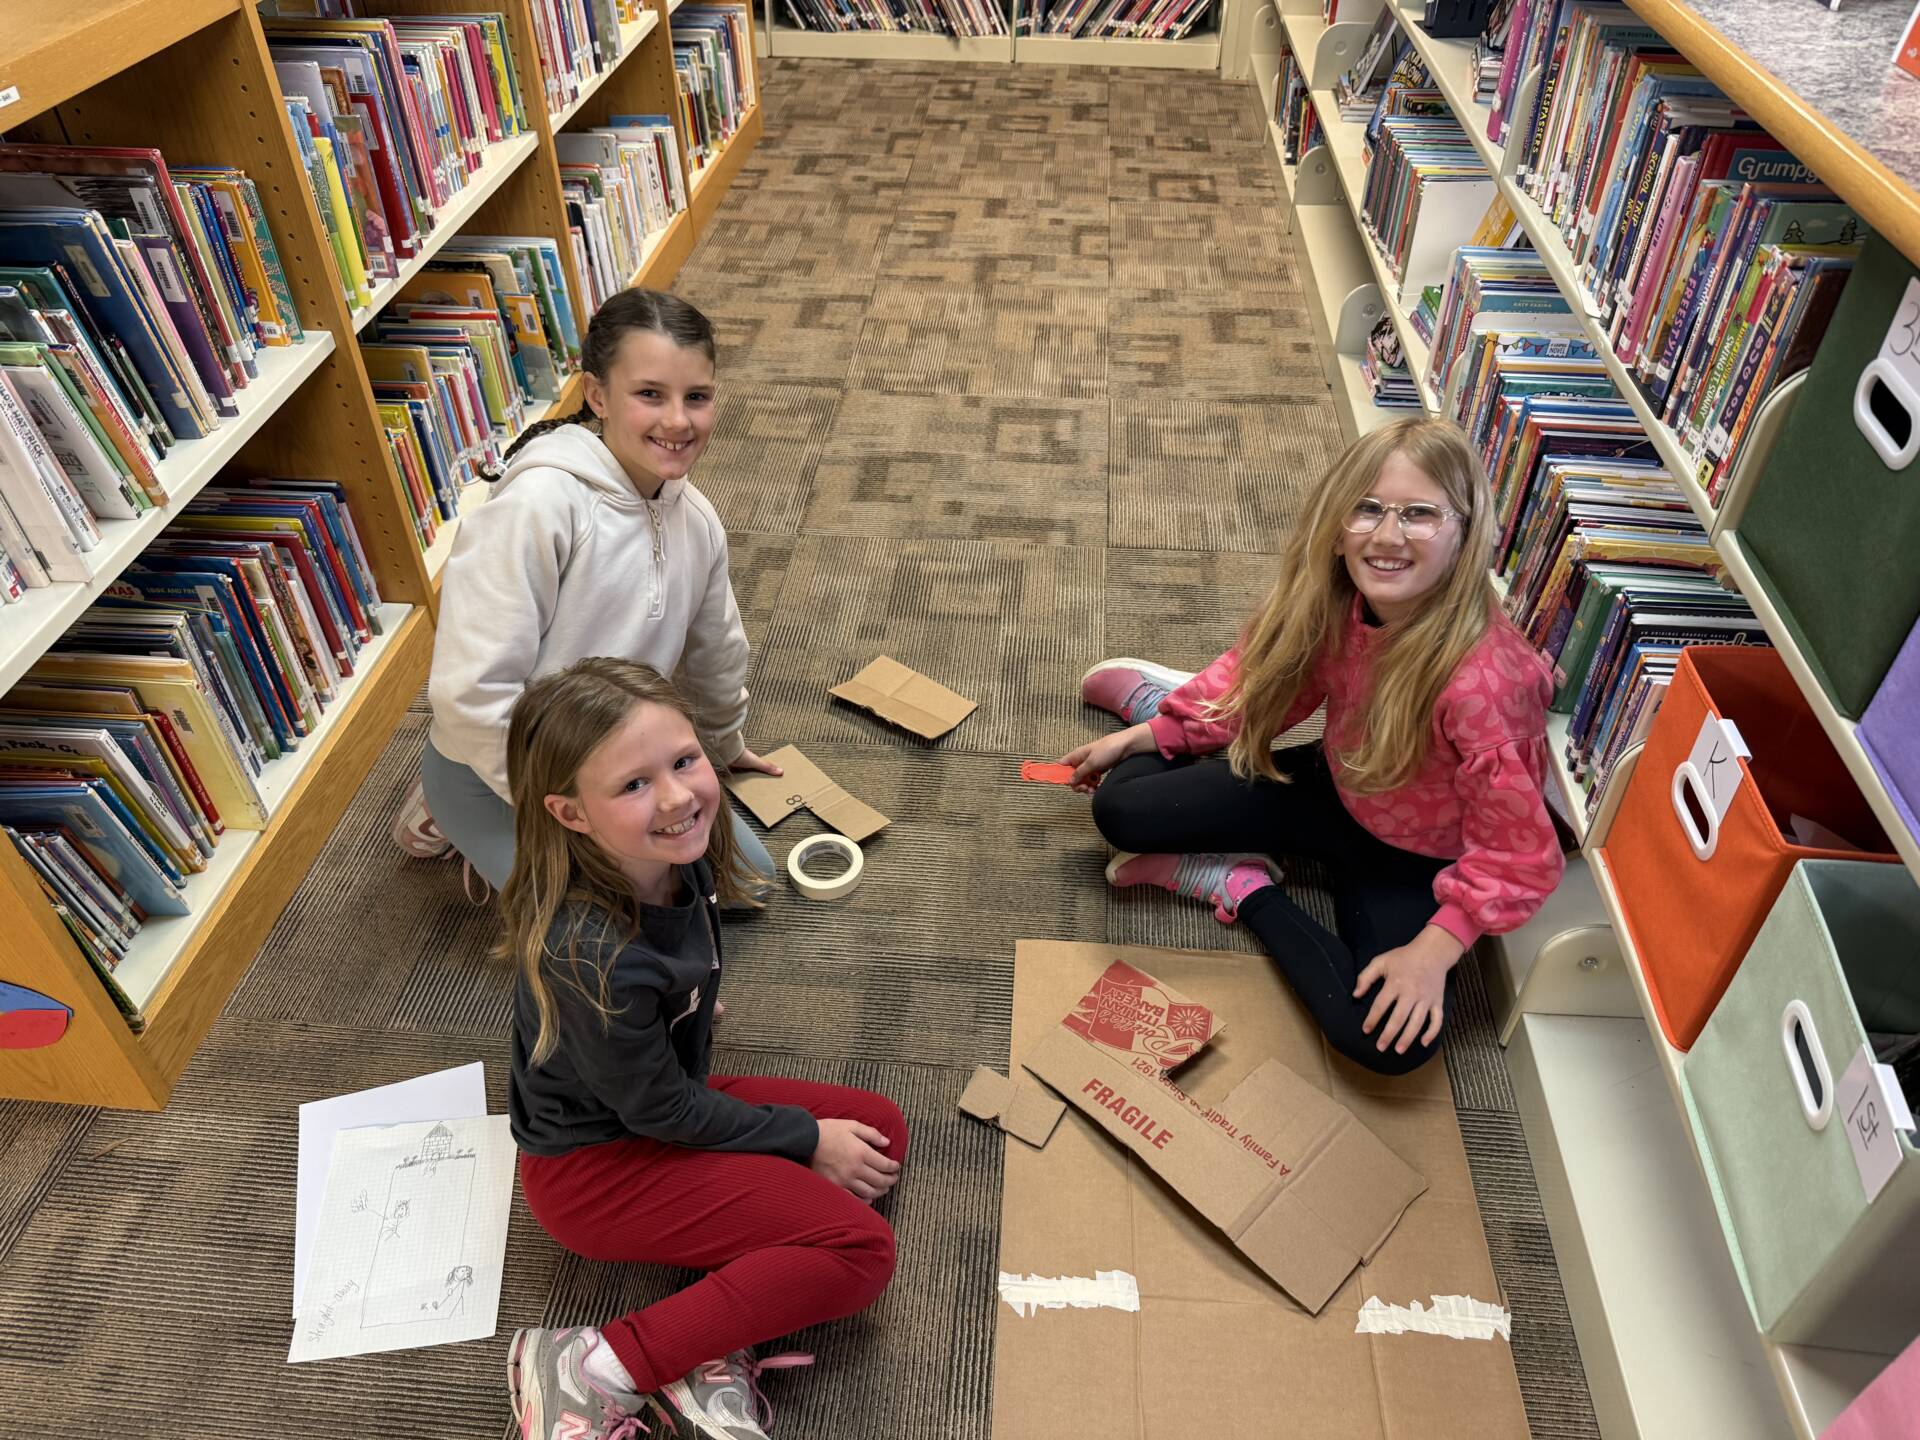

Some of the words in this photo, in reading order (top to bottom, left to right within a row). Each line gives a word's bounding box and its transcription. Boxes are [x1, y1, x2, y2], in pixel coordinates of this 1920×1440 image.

[1532, 79, 1555, 154] TRESPASSERS
[1639, 151, 1661, 195] SCHOOL
[1632, 199, 1645, 227] TRIP
[1651, 216, 1666, 249] FIFTH
[1663, 277, 1697, 366] FREESTYLE
[1720, 335, 1735, 369] SWING
[1742, 335, 1764, 380] BUG
[1699, 383, 1716, 419] SUNNY
[13, 410, 26, 429] HAT
[25, 430, 45, 458] TRICK
[1703, 740, 1728, 800] K
[1100, 997, 1157, 1027] ITALIAN
[1104, 988, 1166, 1018] BAKERY
[1098, 1008, 1206, 1063] Rotella's
[1131, 1056, 1158, 1079] 1921
[1081, 1078, 1174, 1150] FRAGILE
[1239, 1134, 1280, 1170] Family
[1279, 1163, 1292, 1177] A
